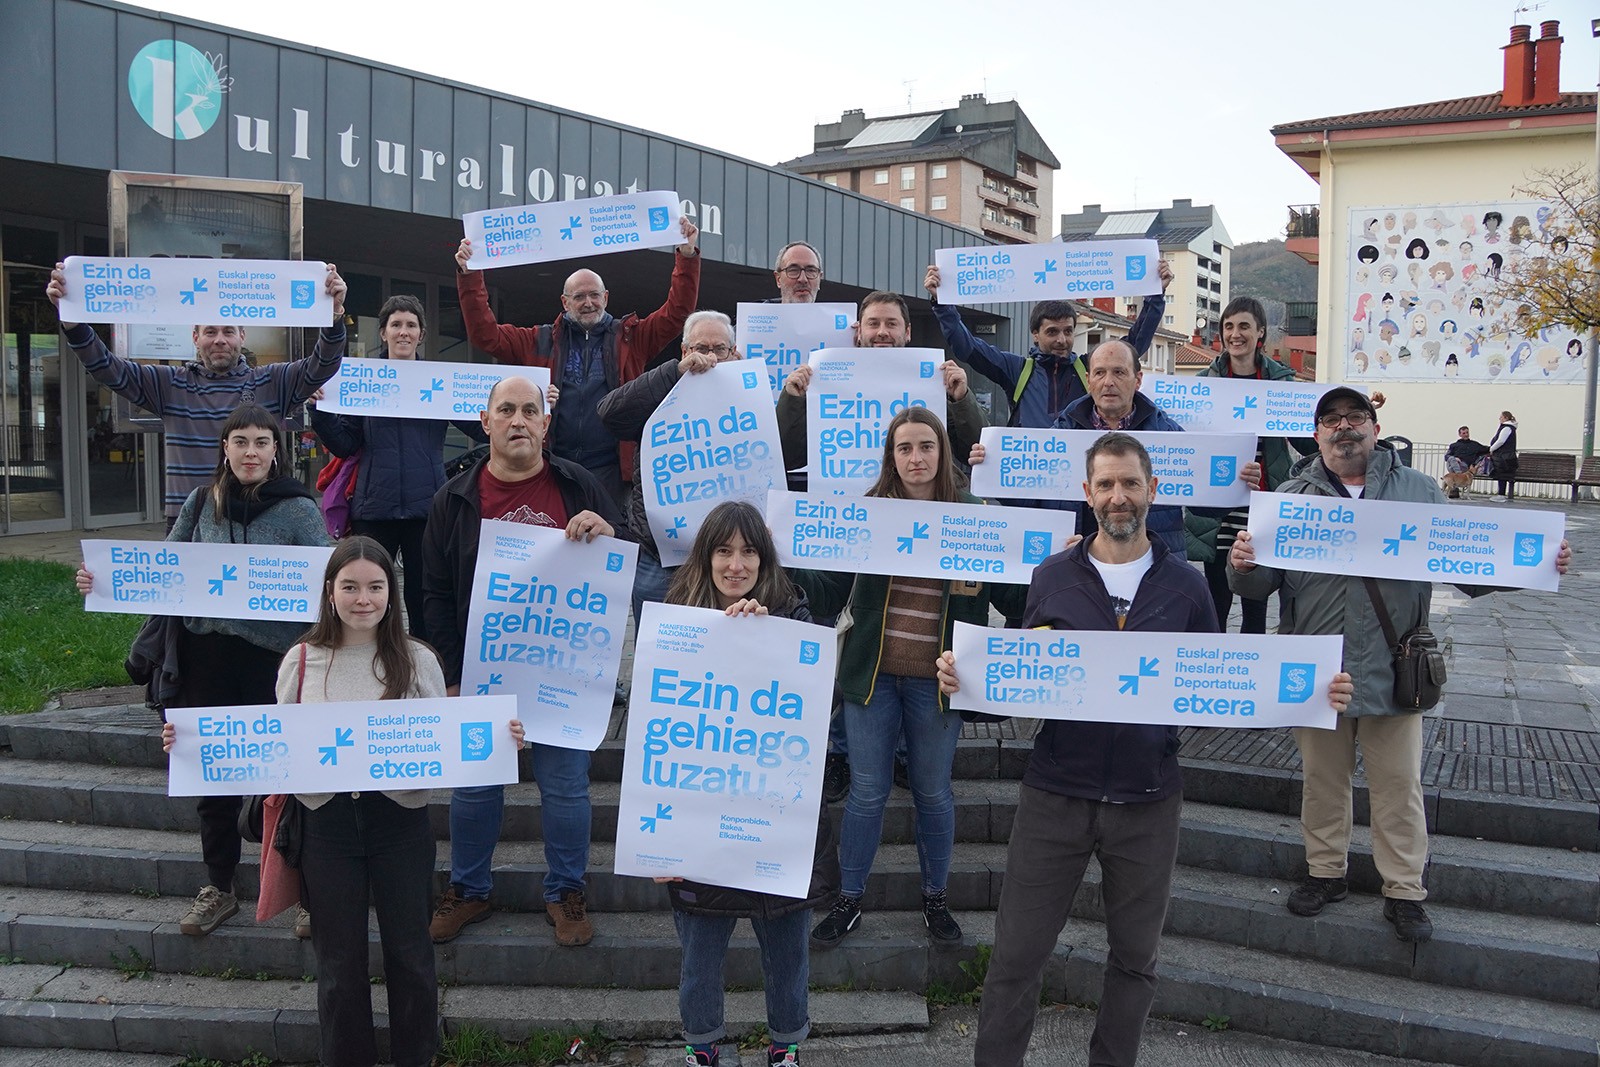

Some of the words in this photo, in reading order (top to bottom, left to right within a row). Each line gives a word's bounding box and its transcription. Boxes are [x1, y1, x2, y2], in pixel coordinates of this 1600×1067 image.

[589, 206, 613, 215] Euskal
[615, 204, 636, 212] preso
[483, 215, 514, 229] Ezin
[517, 211, 536, 225] da
[590, 214, 618, 223] Iheslari
[591, 221, 637, 232] Deportatuak
[485, 227, 541, 246] gehiago
[593, 231, 640, 246] etxera
[957, 253, 988, 267] Ezin
[992, 251, 1010, 264] da
[83, 264, 122, 279] Ezin
[128, 264, 150, 279] da
[219, 271, 248, 279] Euskal
[251, 272, 276, 281] preso
[957, 269, 1015, 285] gehiago
[1066, 268, 1113, 277] Deportatuak
[85, 282, 156, 299] gehiago
[219, 281, 252, 290] Iheslari
[1067, 279, 1114, 292] etxera
[219, 291, 276, 301] Deportatuak
[220, 304, 276, 318] etxera
[746, 343, 801, 365] Ezin
[340, 363, 372, 378] Ezin
[378, 365, 396, 379] da
[339, 380, 400, 396] gehiago
[452, 382, 482, 390] Iheslari
[1155, 380, 1186, 394] Ezin
[1191, 382, 1210, 396] da
[452, 391, 488, 400] Deportat
[1266, 390, 1293, 399] Euskal
[1294, 392, 1316, 401] preso
[453, 400, 486, 413] etxe
[820, 392, 881, 419] Ezin
[1155, 397, 1214, 412] gehiago
[1266, 399, 1296, 408] Iheslari
[1266, 408, 1315, 418] Deportatuak
[651, 413, 711, 448] Ezin
[718, 406, 758, 435] da
[1266, 418, 1315, 431] etxera
[820, 422, 886, 456] gehi
[1001, 436, 1038, 452] Ezin
[1044, 436, 1067, 453] da
[1146, 444, 1165, 454] skal
[1168, 447, 1195, 456] preso
[652, 441, 769, 484] gehiago
[1000, 454, 1071, 475] gehiago
[1149, 455, 1170, 465] slari
[1173, 458, 1189, 466] eta
[1151, 469, 1194, 478] ortatuak
[795, 500, 837, 519] Ezin
[842, 503, 868, 521] da
[1279, 502, 1323, 522] Ezin
[1328, 505, 1355, 524] da
[942, 515, 976, 526] Euskal
[979, 519, 1008, 529] preso
[1431, 518, 1466, 529] Euskal
[1468, 520, 1499, 532] preso
[793, 521, 871, 543] gehiago
[941, 529, 980, 539] Iheslari
[983, 530, 1000, 540] eta
[1276, 524, 1357, 547] gehiago
[1429, 529, 1470, 541] Iheslari
[1473, 532, 1490, 542] eta
[496, 536, 536, 546] MANIFESTAZIO
[496, 540, 526, 550] NAZIONALA
[940, 540, 1005, 553] Deportatuak
[1428, 542, 1495, 556] Deportatuak
[111, 547, 150, 565] Ezin
[155, 548, 179, 566] da
[248, 557, 280, 566] Euskal
[282, 559, 309, 569] preso
[939, 554, 1005, 574] etxera
[1427, 556, 1495, 576] etxera
[112, 567, 184, 587] gehiago
[248, 569, 285, 579] Iheslari
[248, 581, 308, 592] Deportatuak
[487, 572, 558, 605] Ezin
[566, 582, 608, 616] da
[248, 596, 308, 613] etxera
[481, 606, 611, 650] gehiago
[658, 629, 698, 638] NAZIONALA
[659, 622, 708, 634] MANIFESTAZIO
[986, 637, 1041, 657] Ezin
[1048, 638, 1081, 658] da
[1176, 648, 1220, 660] Euskal
[1223, 650, 1260, 663] preso
[985, 660, 1086, 686] gehiago
[1175, 662, 1224, 675] Iheslari
[1228, 664, 1249, 675] eta
[1174, 677, 1256, 691] Deportatuak
[650, 668, 739, 712] Ezin
[749, 680, 803, 720] da
[1173, 696, 1256, 717] etxera
[198, 716, 247, 737] Ezin
[252, 714, 282, 734] da
[367, 715, 406, 727] Euskal
[408, 714, 441, 727] preso
[367, 728, 412, 740] Iheslari
[415, 729, 434, 740] eta
[643, 714, 810, 768] gehiago
[200, 739, 289, 764] gehiago
[368, 742, 441, 755] Deportatuak
[369, 759, 442, 780] etxera
[720, 814, 772, 826] Konponbidea.
[720, 822, 744, 832] Bakea.
[719, 831, 762, 842] Elkarbizitza.
